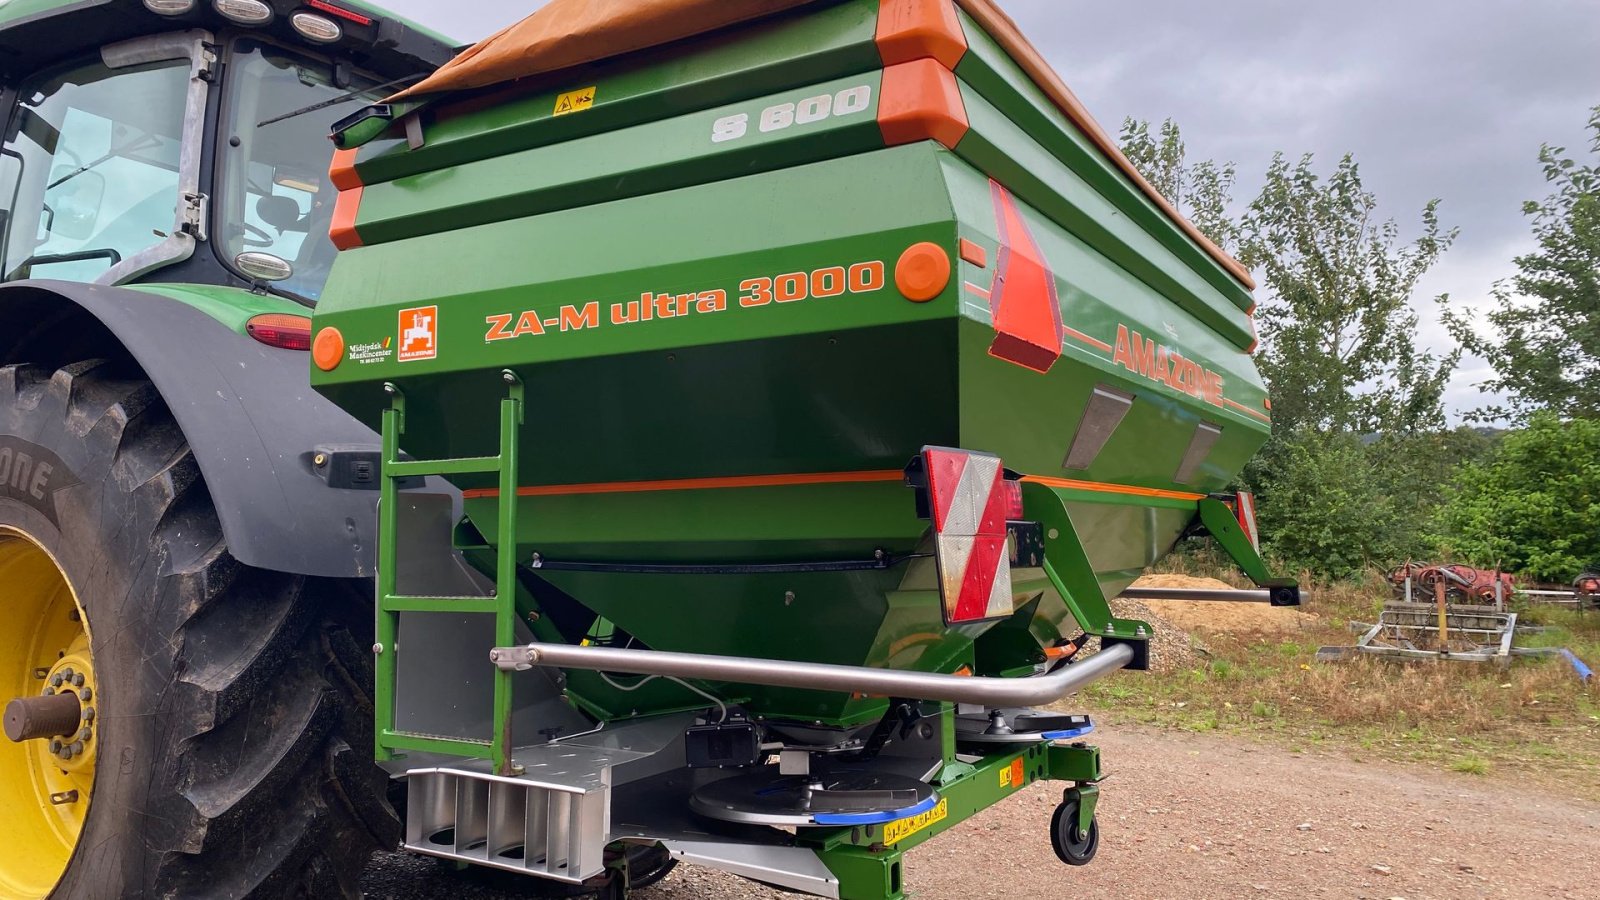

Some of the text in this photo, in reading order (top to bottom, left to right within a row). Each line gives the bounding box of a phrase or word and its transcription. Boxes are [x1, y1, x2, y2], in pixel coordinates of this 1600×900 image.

[711, 85, 871, 143] S 600
[485, 260, 884, 341] ZA-M ultra 3000
[1113, 323, 1224, 409] AMAZONE
